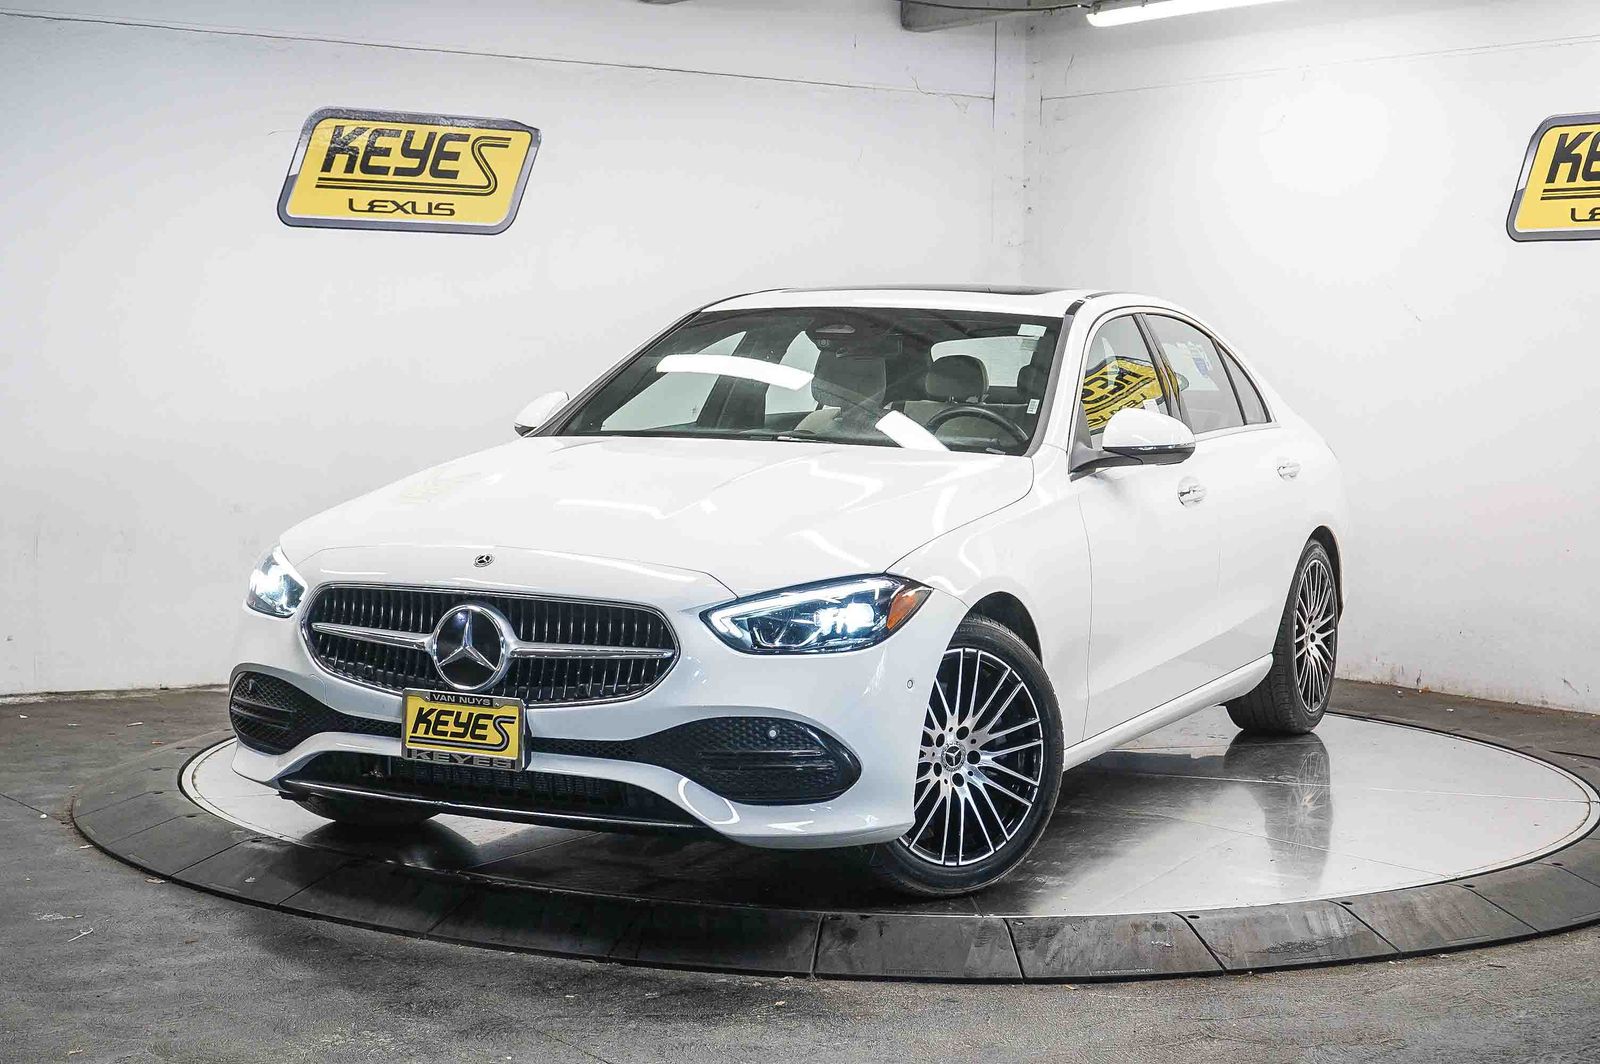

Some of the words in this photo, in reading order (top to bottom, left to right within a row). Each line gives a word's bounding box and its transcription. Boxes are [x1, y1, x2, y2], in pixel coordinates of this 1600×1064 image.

[316, 125, 512, 196] KEYES
[348, 198, 455, 216] LEXUS
[432, 693, 456, 703] VAN
[459, 695, 491, 706] NUYS
[408, 706, 517, 752] KEYES
